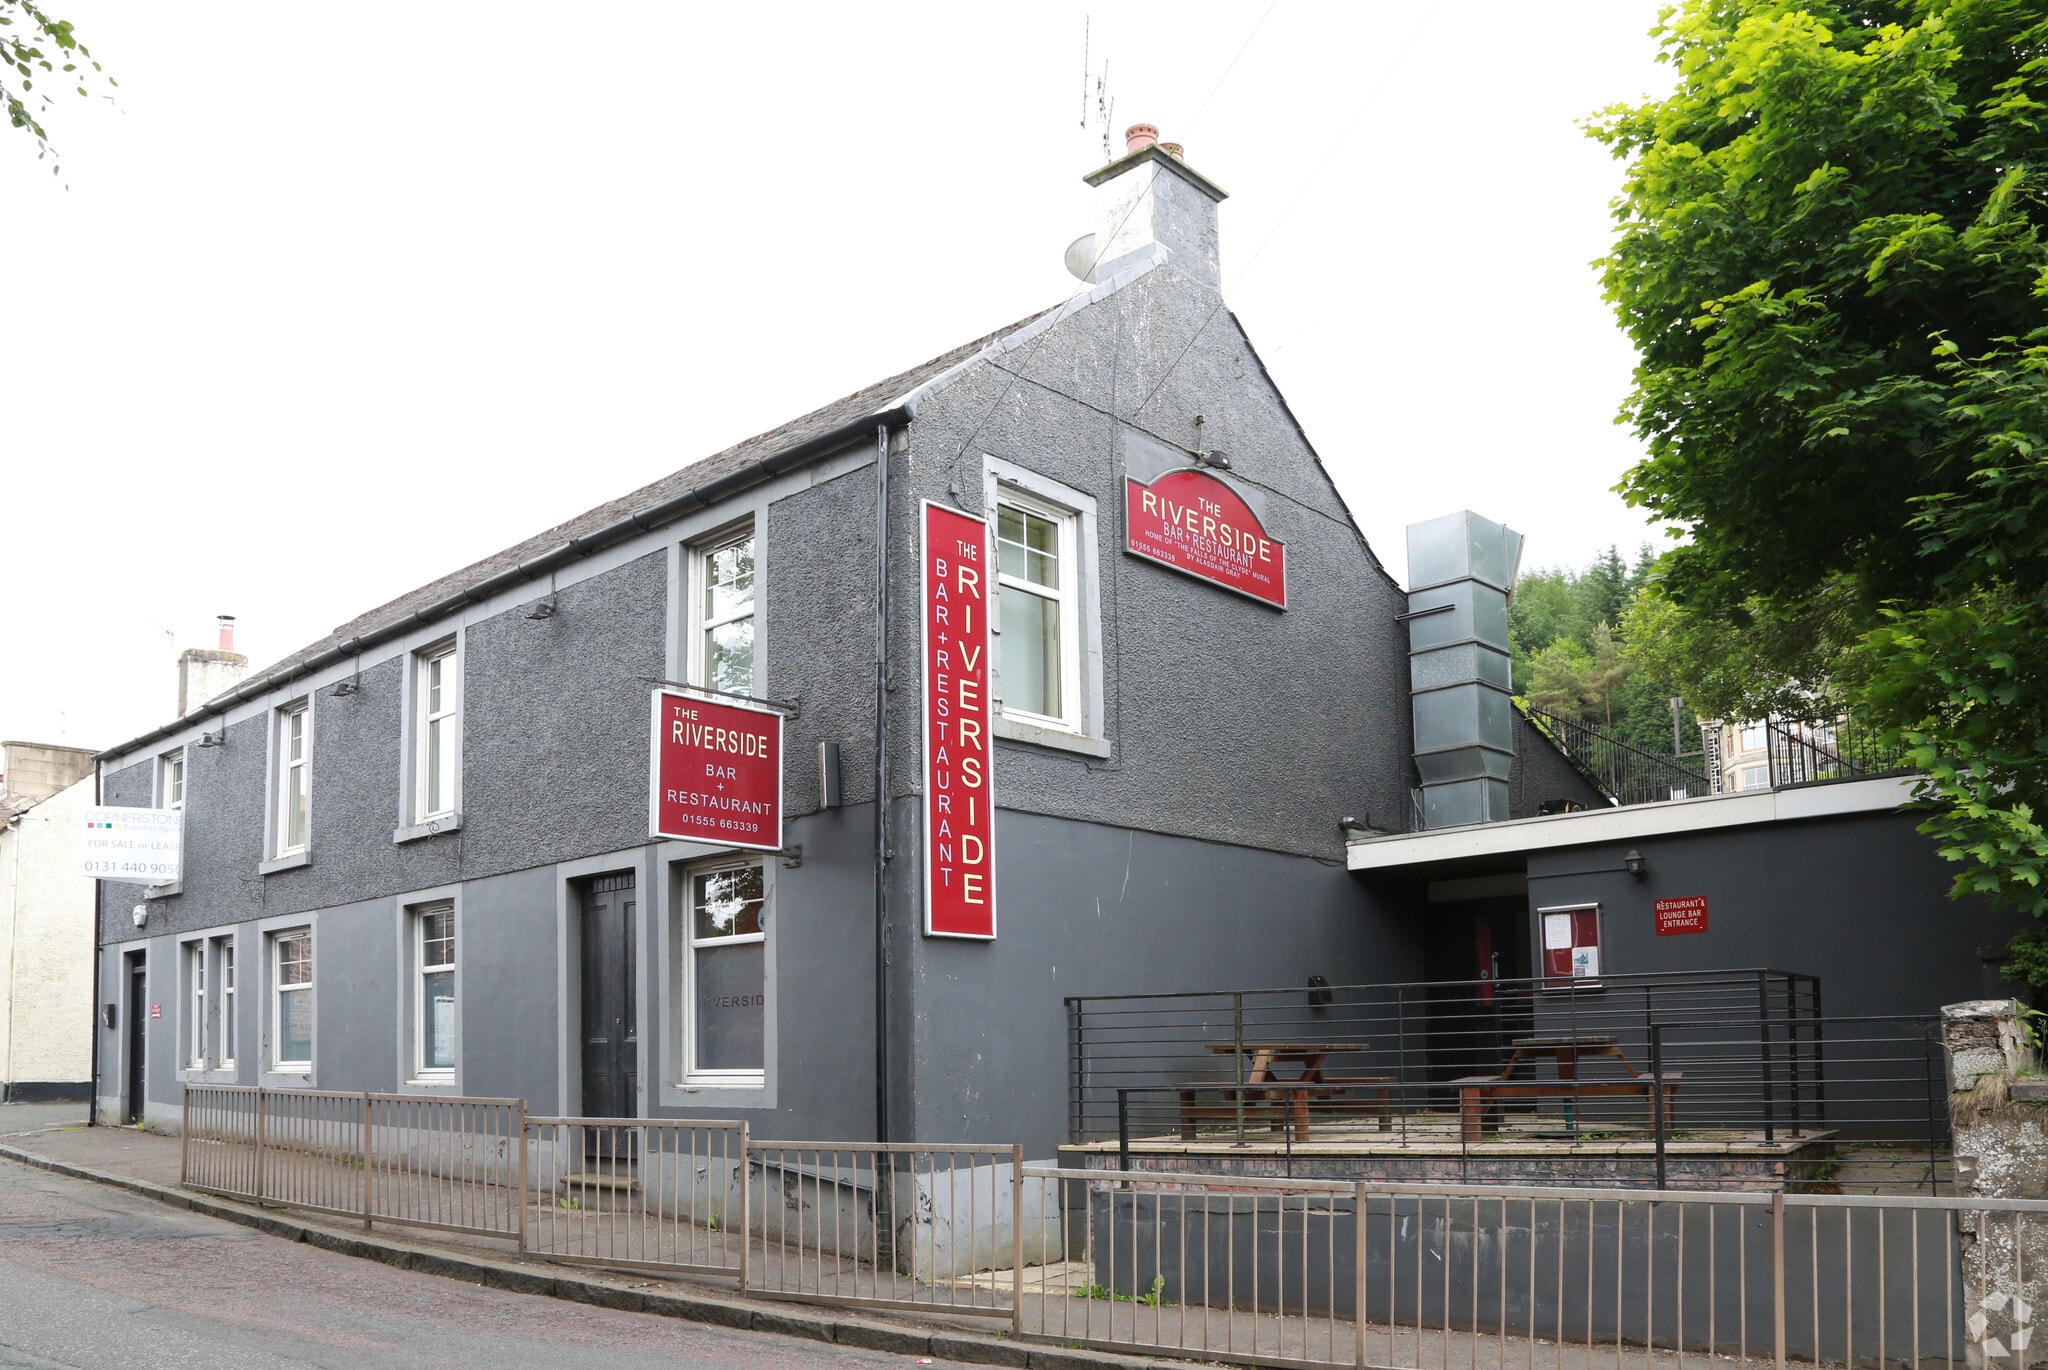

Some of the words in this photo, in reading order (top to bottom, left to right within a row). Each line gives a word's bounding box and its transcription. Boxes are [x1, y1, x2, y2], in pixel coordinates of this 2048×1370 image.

[1198, 497, 1221, 518] THE
[1142, 490, 1271, 562] RIVERSIDE
[957, 539, 977, 562] THE
[1131, 539, 1151, 553] 01555
[1152, 548, 1176, 562] 663339
[1163, 522, 1184, 542] BAR
[1192, 534, 1254, 569] RESTAURANT
[1145, 530, 1163, 542] HOME
[1165, 537, 1173, 545] OF
[1190, 547, 1208, 560] FALLS
[1209, 555, 1217, 563] OF
[1219, 558, 1231, 568] THE
[1252, 572, 1271, 584] MURAL
[1186, 553, 1195, 561] BY
[1196, 556, 1224, 573] ALASDAIR
[1225, 568, 1241, 579] GRAY
[673, 706, 699, 721] THE
[672, 720, 768, 759] RIVERSIDE
[957, 564, 985, 905] RIVERSIDE
[705, 763, 737, 780] BAR
[717, 782, 724, 791] +
[667, 789, 772, 816] RESTAURANT
[682, 813, 716, 827] 01555
[719, 819, 759, 833] 663339
[88, 839, 109, 848] FOR
[111, 840, 135, 849] SALE
[151, 841, 182, 852] LEASE
[84, 861, 117, 872] 0131
[121, 862, 147, 873] 440
[1656, 900, 1699, 910] RESTAURANT
[1701, 899, 1705, 907] &
[1660, 910, 1686, 920] LOUNGE
[1688, 909, 1702, 918] BAR
[1663, 918, 1699, 928] ENTRANCE
